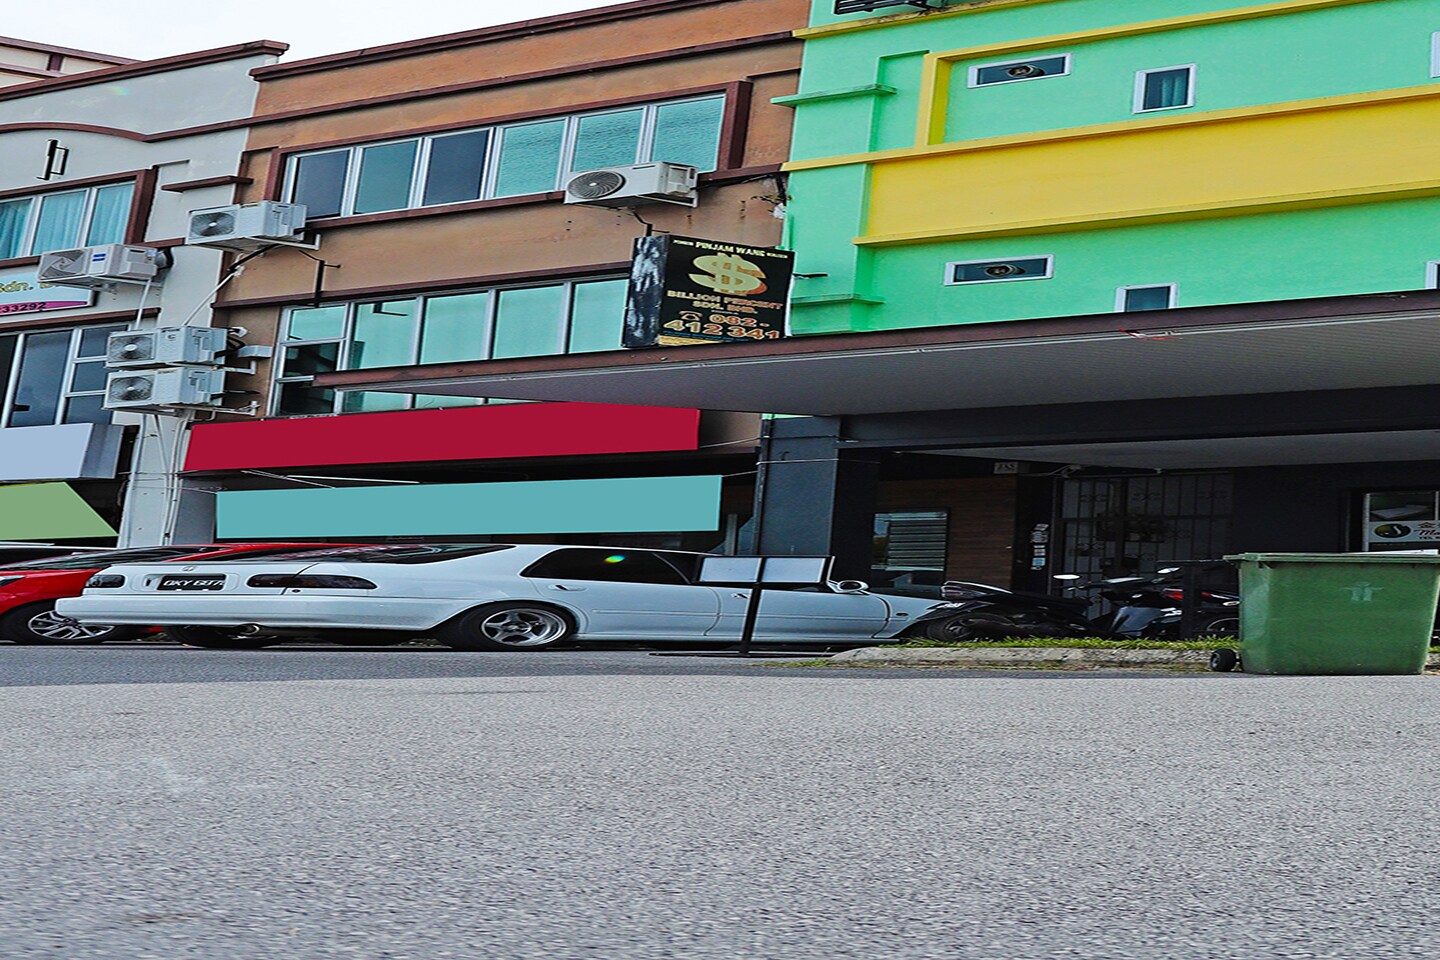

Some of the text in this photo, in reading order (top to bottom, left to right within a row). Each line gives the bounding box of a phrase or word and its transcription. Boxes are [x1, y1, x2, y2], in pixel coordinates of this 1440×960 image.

[667, 290, 721, 303] BILLION
[0, 302, 47, 313] 33292
[663, 319, 723, 336] 412
[726, 326, 781, 340] 341
